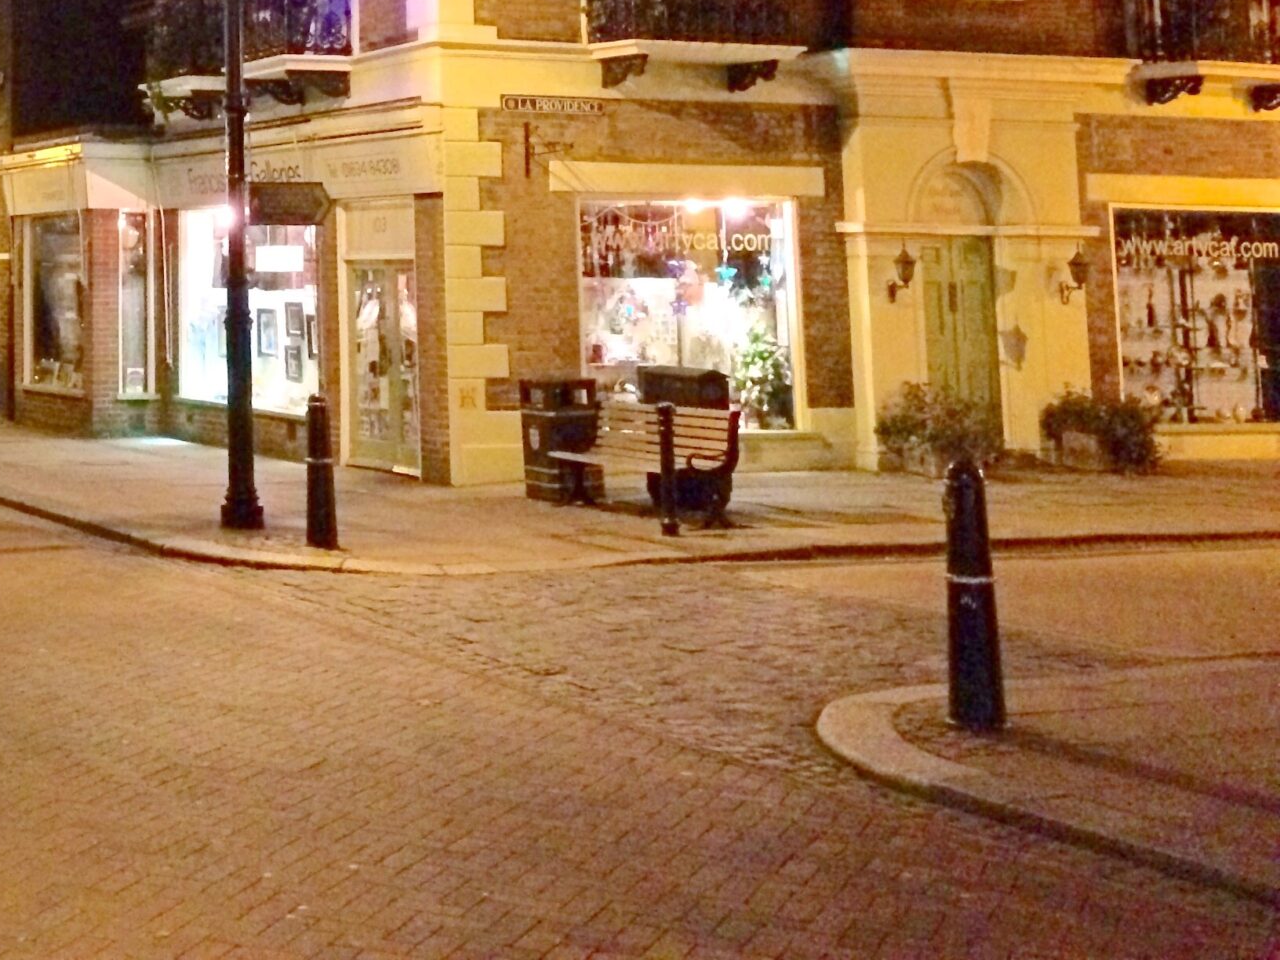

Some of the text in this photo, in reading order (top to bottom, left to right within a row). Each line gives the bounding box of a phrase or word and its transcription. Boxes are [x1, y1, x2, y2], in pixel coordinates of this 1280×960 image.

[519, 99, 599, 113] LA PROVIDENCE
[1120, 237, 1279, 259] www.artycat.com
